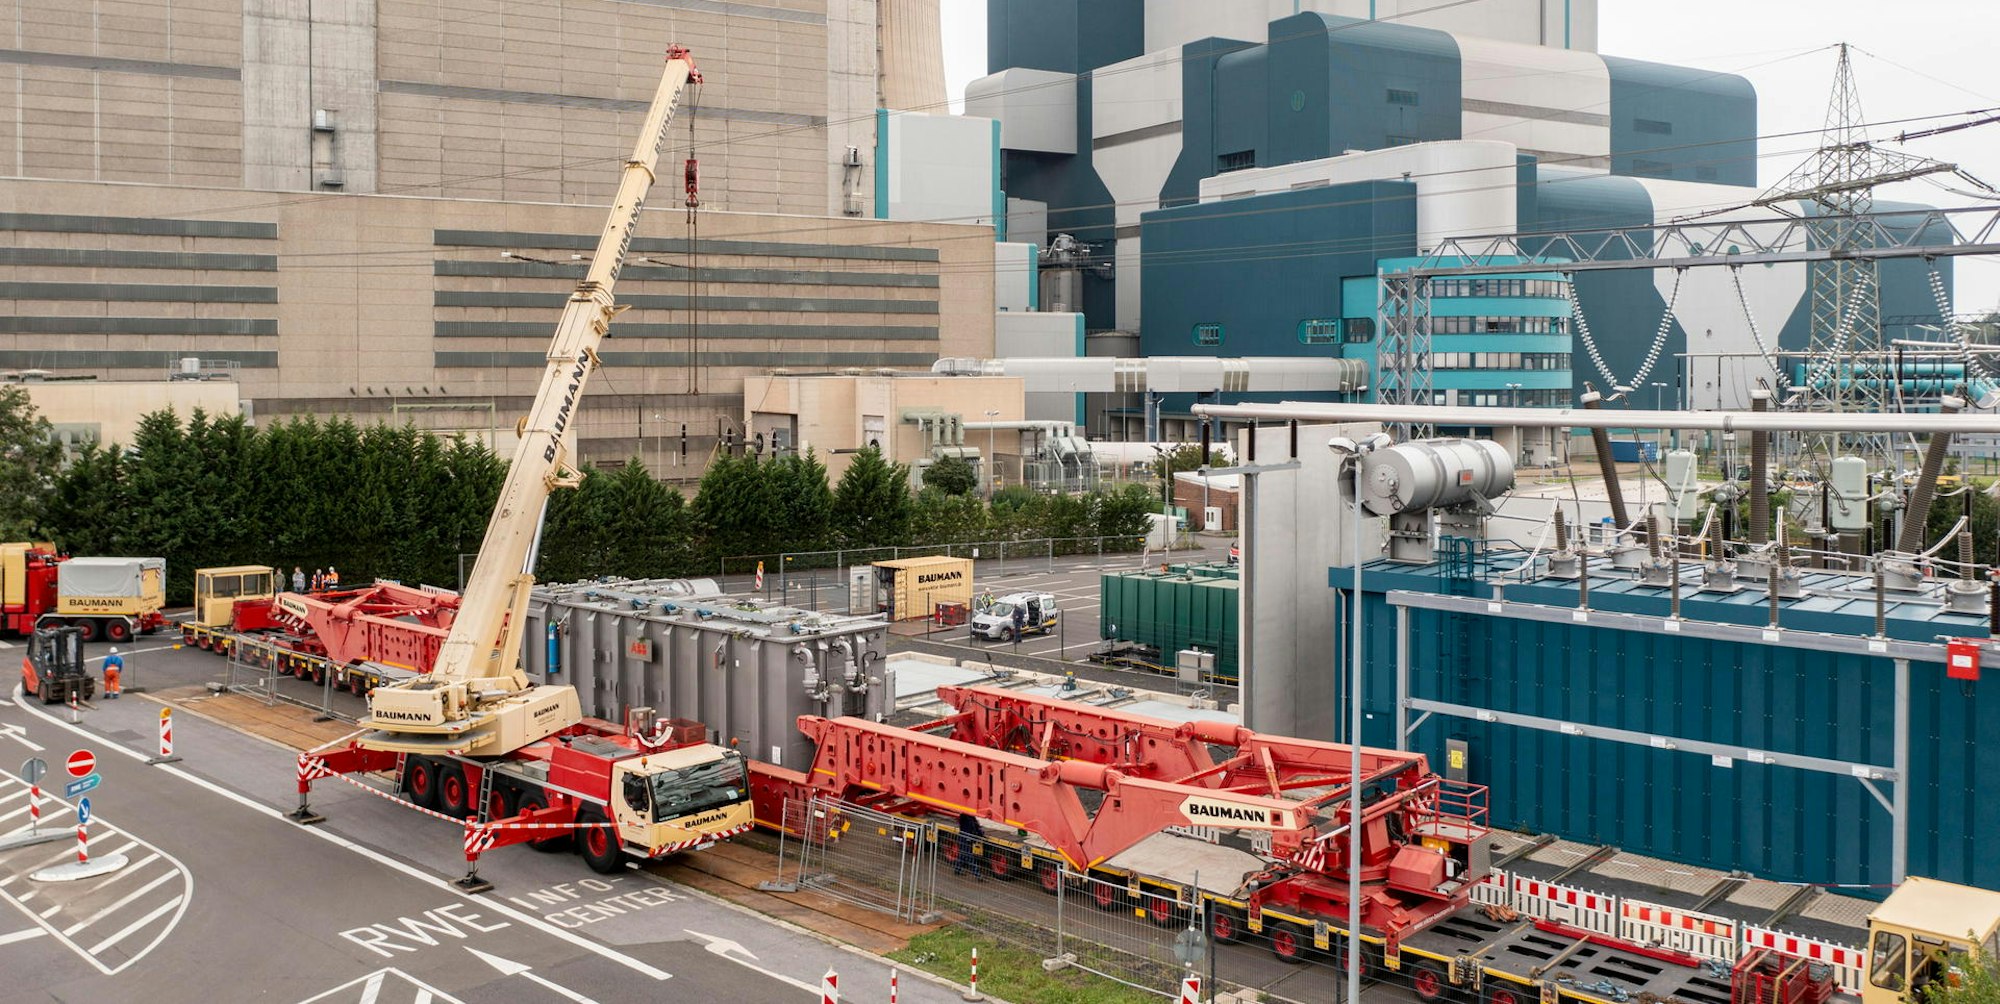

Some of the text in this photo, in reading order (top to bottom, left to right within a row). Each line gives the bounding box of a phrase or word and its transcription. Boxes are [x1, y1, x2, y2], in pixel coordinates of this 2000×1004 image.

[655, 86, 681, 155] BAUMANN
[610, 197, 642, 281] BAUMANN
[544, 349, 589, 464] BAUMANN
[918, 571, 962, 584] BAUMANN
[69, 598, 123, 607] BAUMANN
[283, 599, 306, 614] BAUMANN
[376, 710, 431, 721] BAUMANN
[533, 703, 559, 718] BAUMANN
[684, 812, 728, 828] BAUMANN
[1189, 803, 1265, 823] BAUMANN
[544, 886, 688, 929] CENTER
[338, 903, 512, 958] RWE
